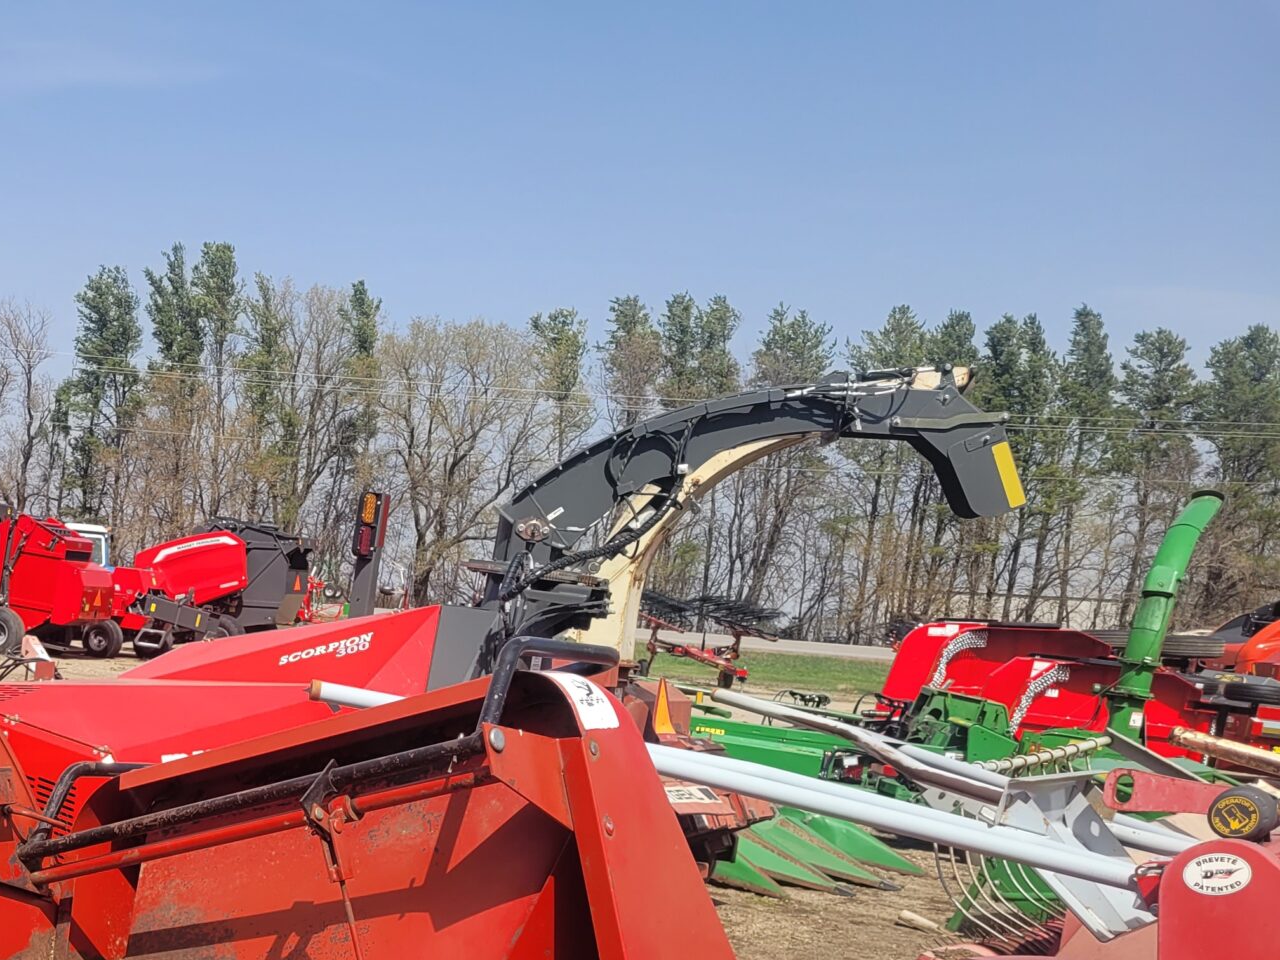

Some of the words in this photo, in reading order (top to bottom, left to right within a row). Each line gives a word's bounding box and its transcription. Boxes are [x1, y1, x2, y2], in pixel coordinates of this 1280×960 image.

[278, 631, 374, 666] SCORPION
[335, 642, 370, 658] 300
[1193, 880, 1242, 893] PATENTED
